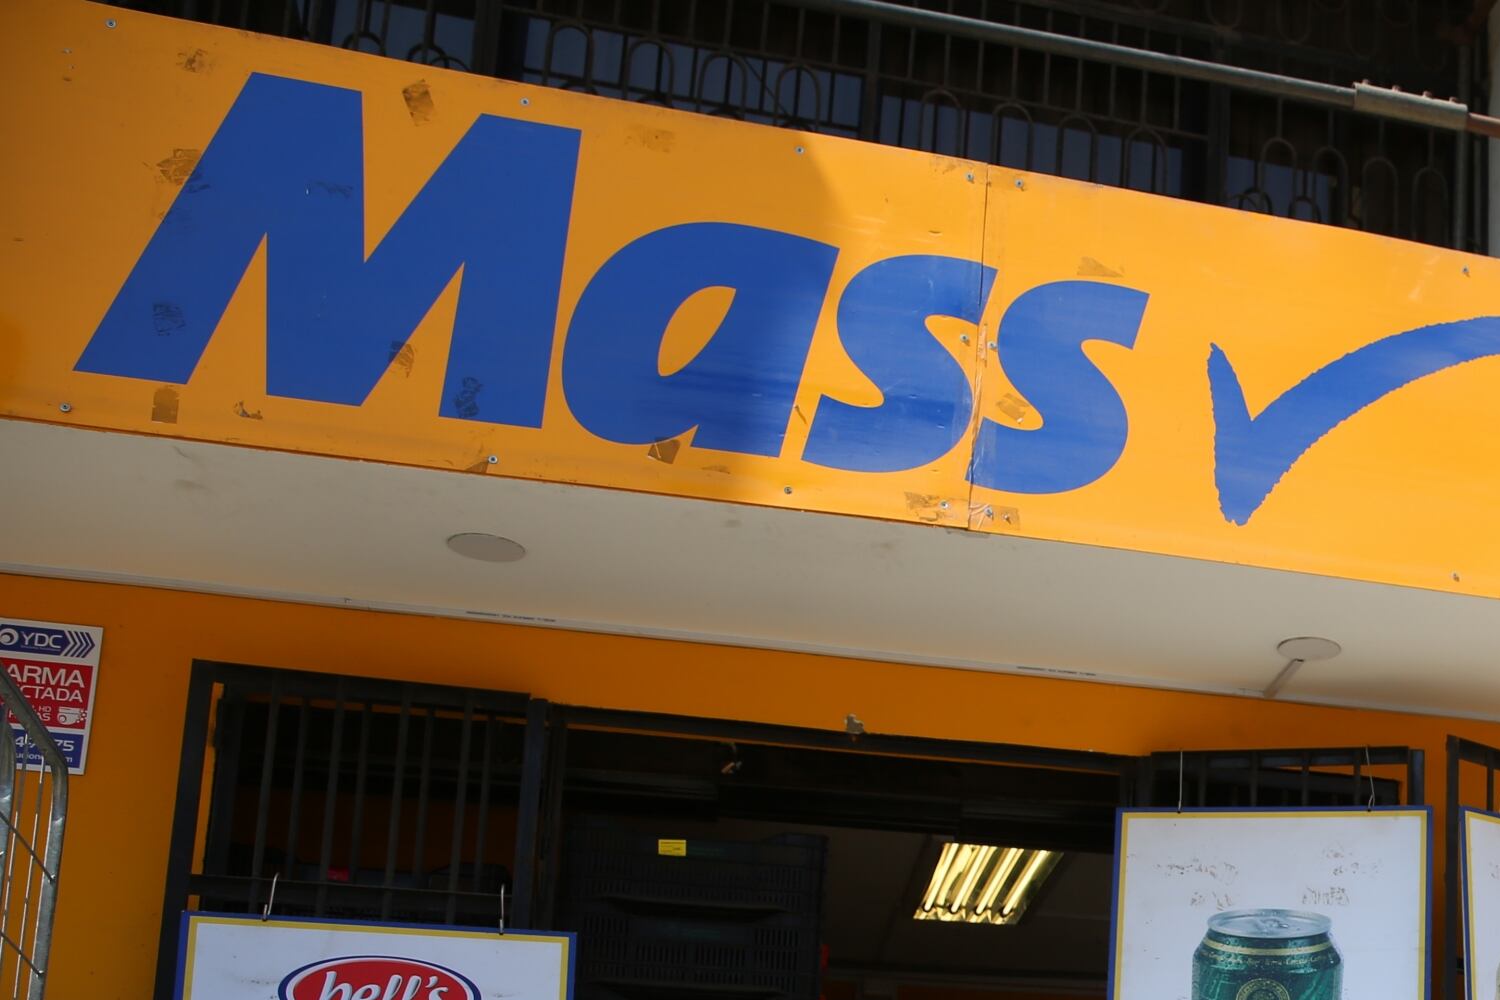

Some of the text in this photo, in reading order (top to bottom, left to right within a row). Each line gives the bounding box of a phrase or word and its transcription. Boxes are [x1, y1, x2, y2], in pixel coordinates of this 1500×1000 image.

[74, 72, 1150, 495] Mass
[21, 631, 63, 649] YDC
[7, 663, 85, 688] ARMA
[18, 684, 83, 703] CTADA
